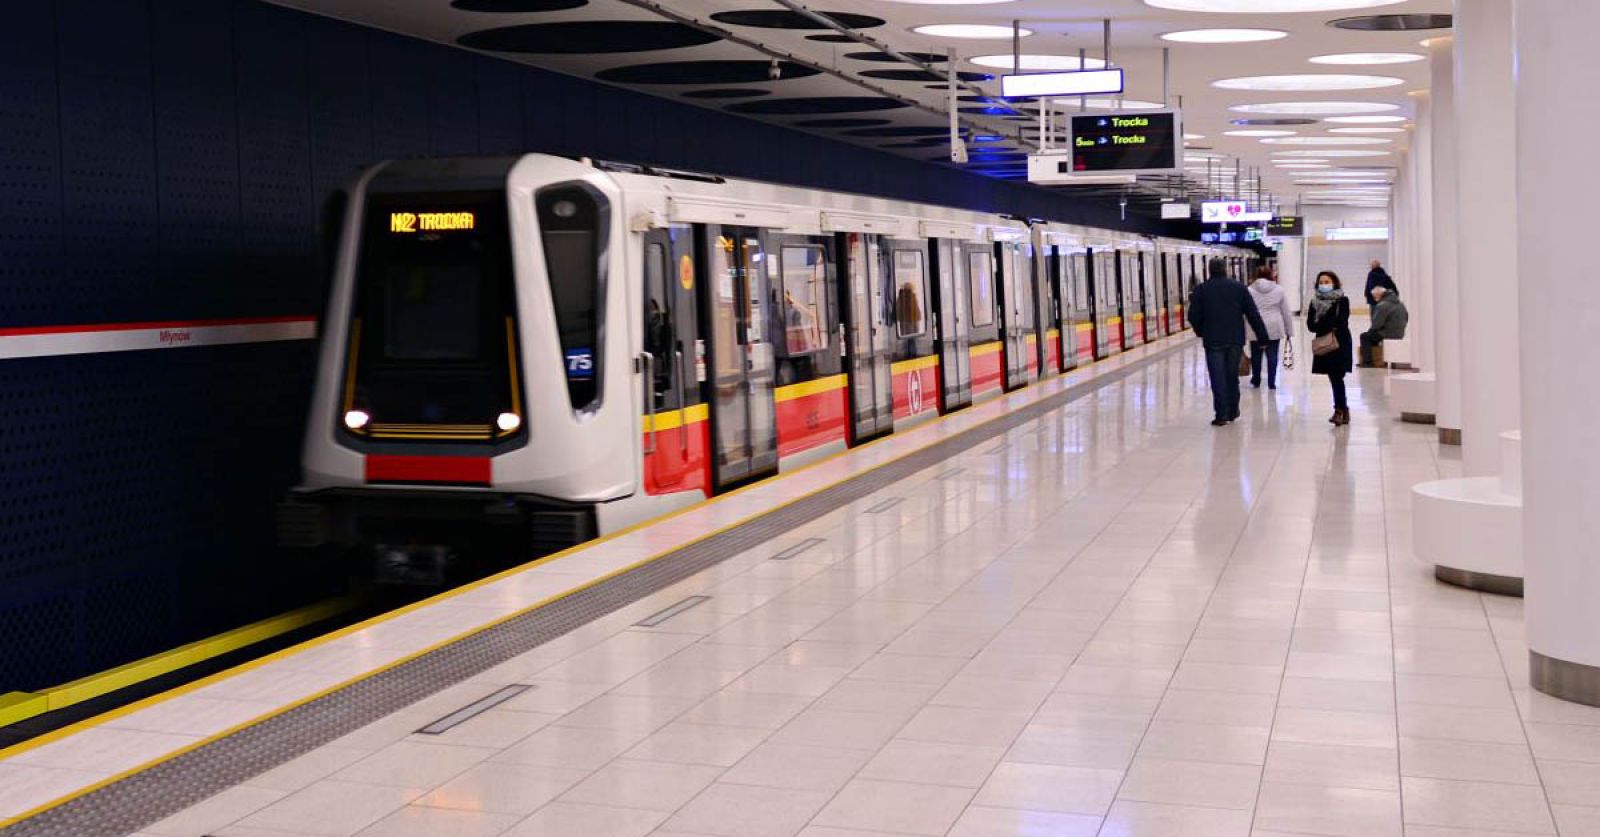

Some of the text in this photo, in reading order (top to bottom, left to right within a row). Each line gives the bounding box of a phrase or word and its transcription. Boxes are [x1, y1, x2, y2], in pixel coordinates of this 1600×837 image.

[1112, 117, 1149, 127] Trocka
[1112, 135, 1146, 144] Trocka
[566, 353, 593, 370] 75
